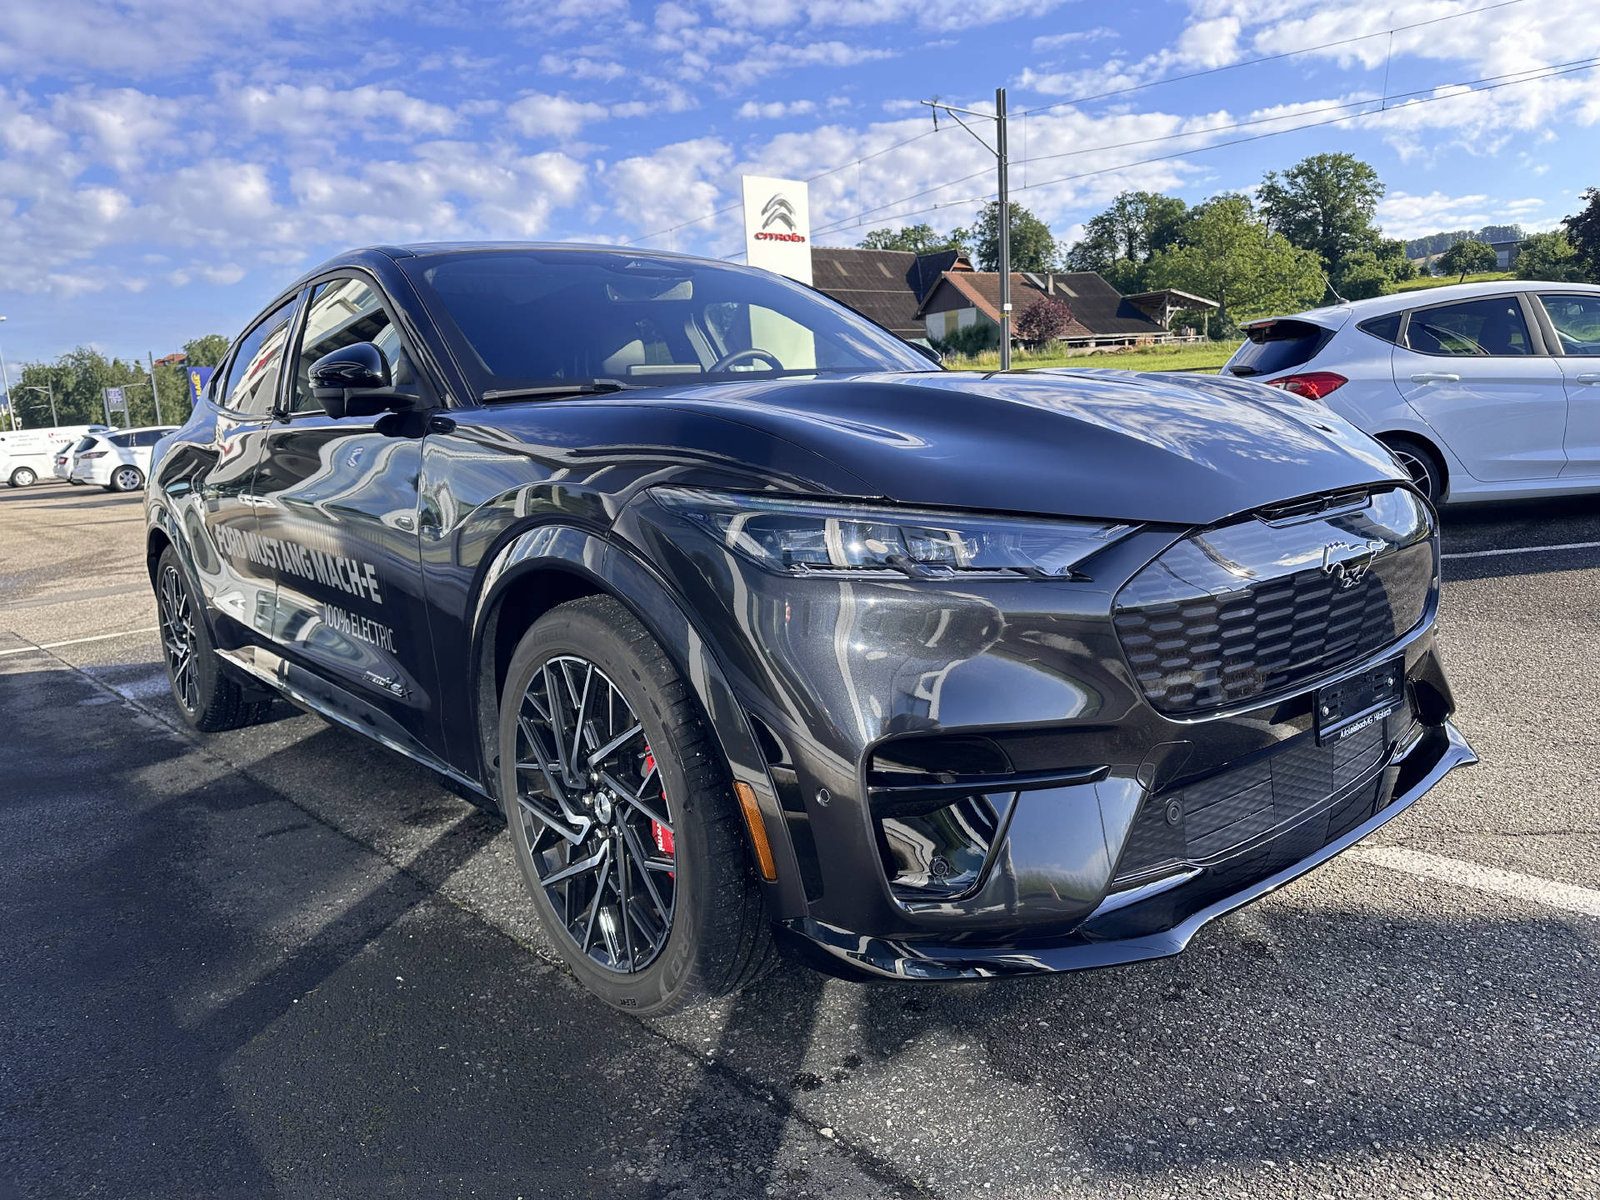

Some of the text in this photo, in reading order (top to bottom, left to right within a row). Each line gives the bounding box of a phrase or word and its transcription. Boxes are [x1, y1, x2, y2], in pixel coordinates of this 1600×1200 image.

[214, 523, 383, 605] FORD MUSTANG MACH-E
[323, 602, 398, 654] 100% ELECTRIC
